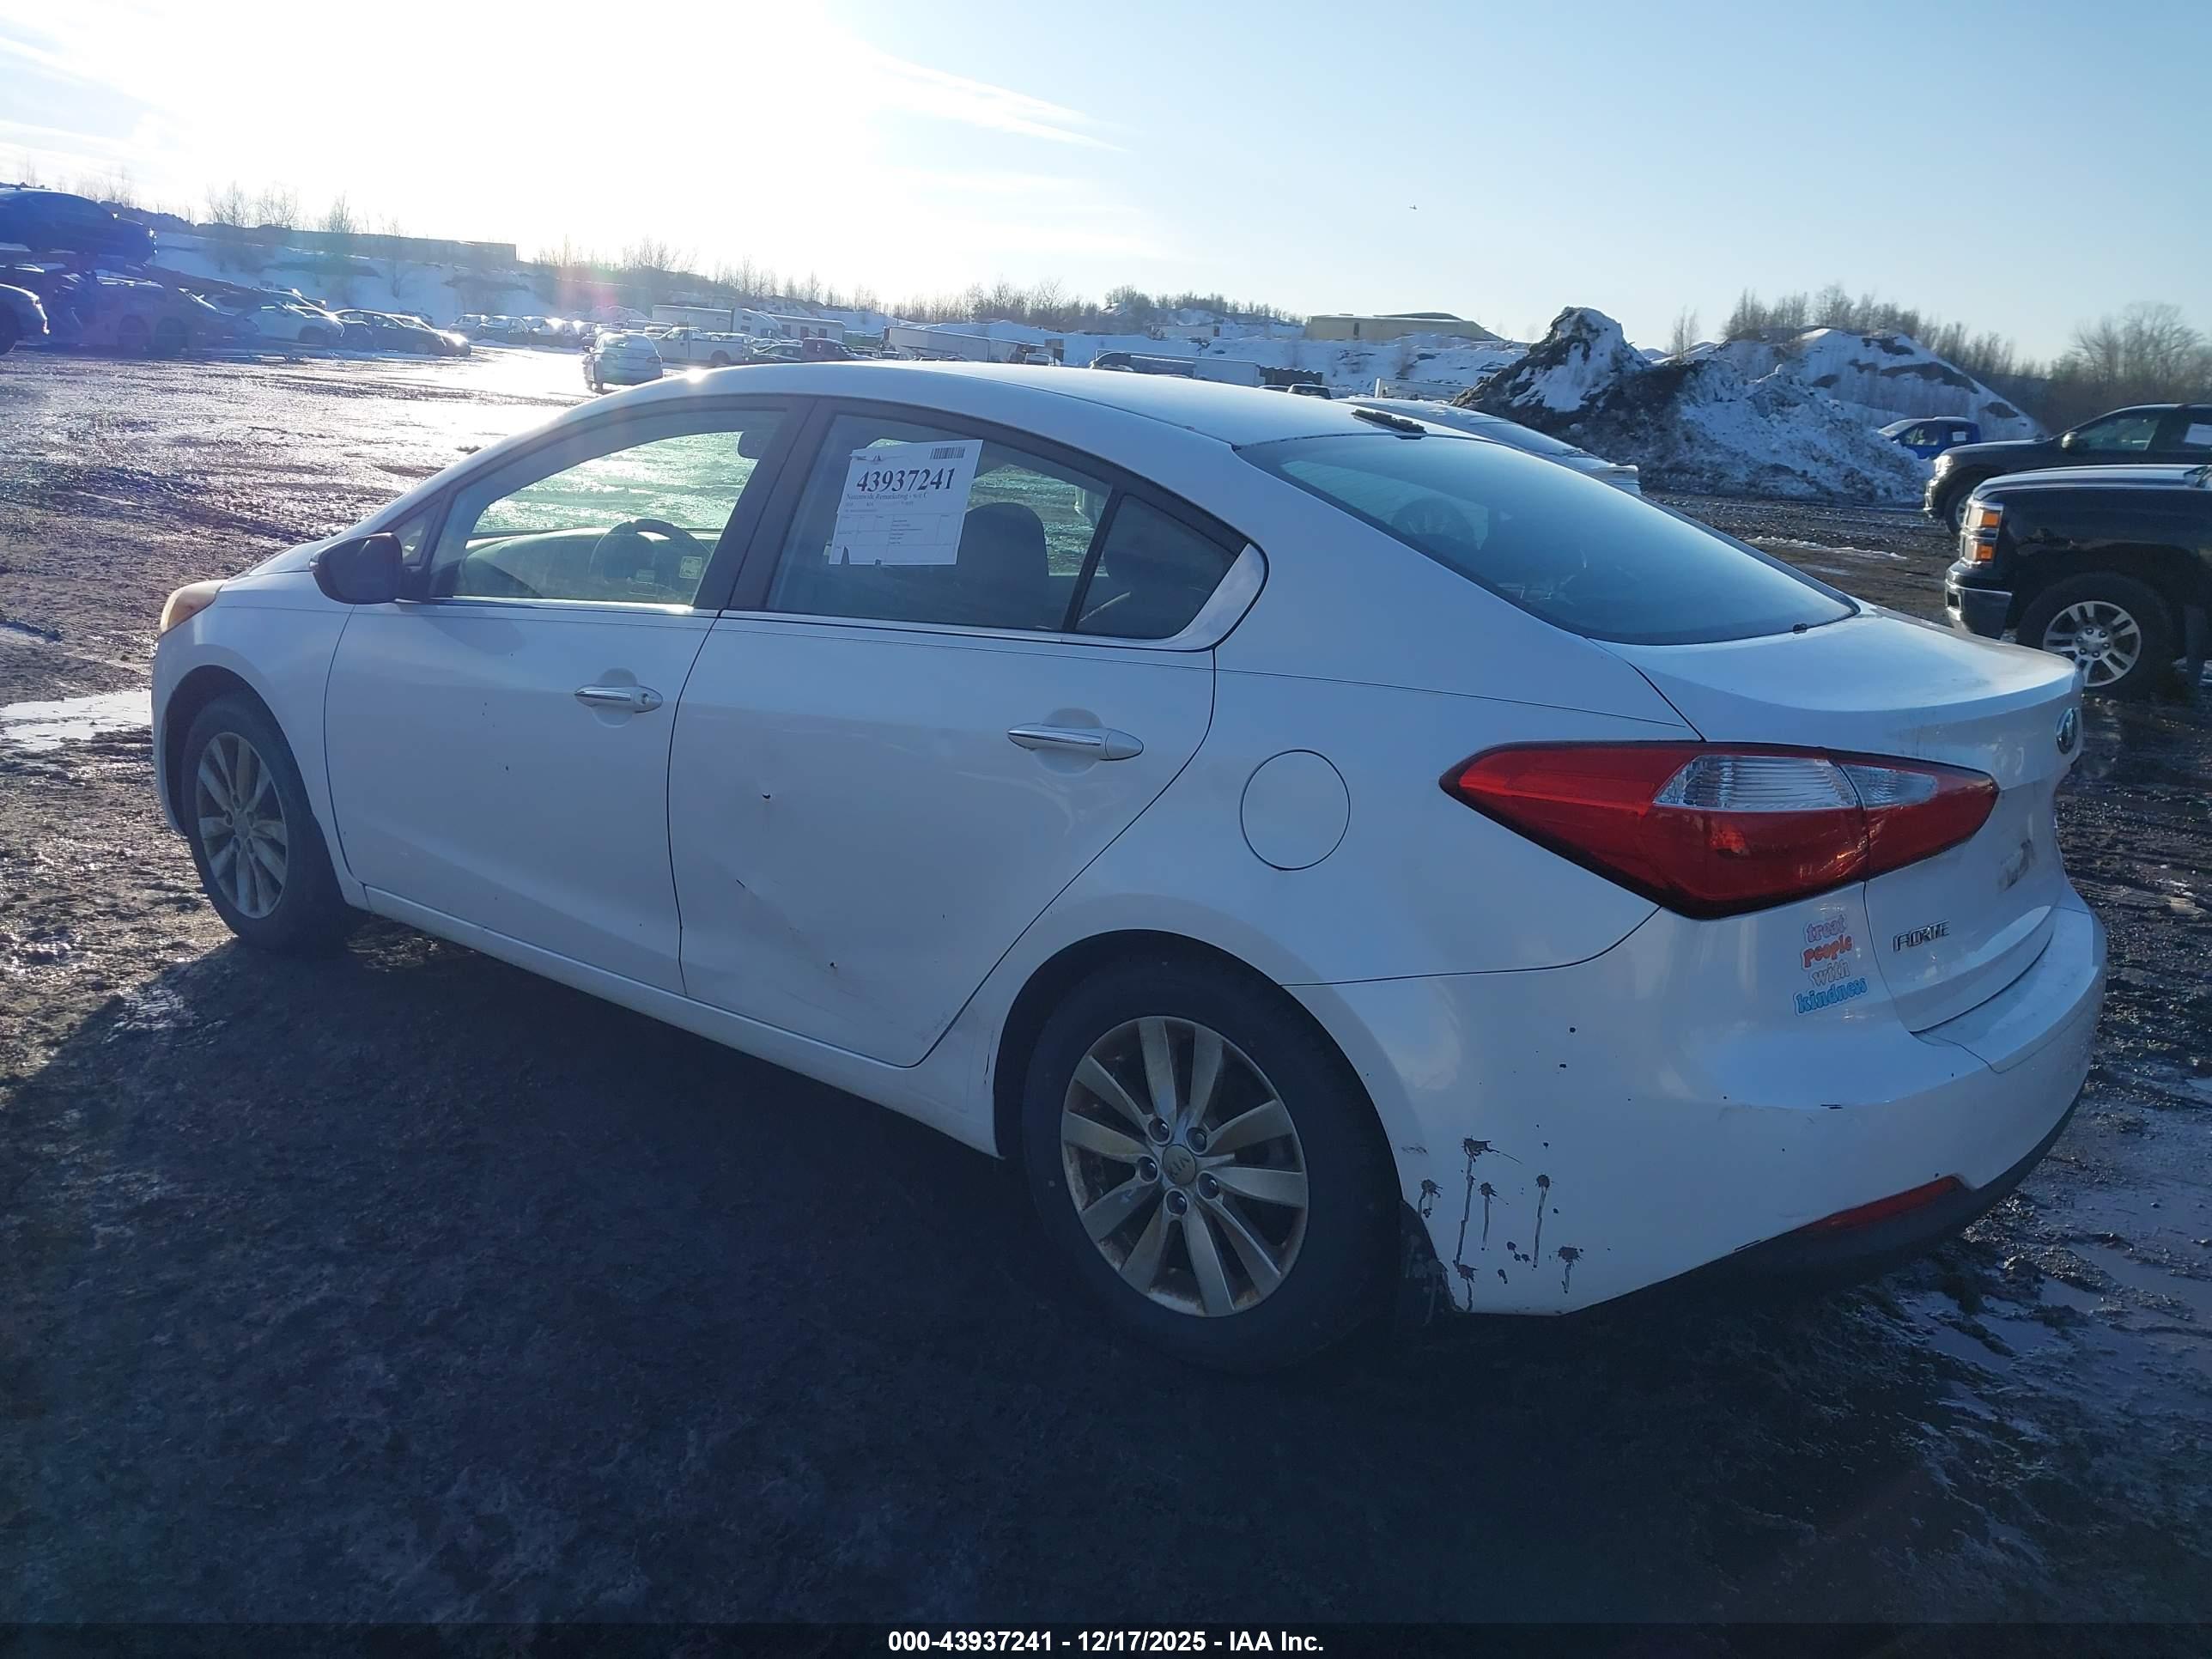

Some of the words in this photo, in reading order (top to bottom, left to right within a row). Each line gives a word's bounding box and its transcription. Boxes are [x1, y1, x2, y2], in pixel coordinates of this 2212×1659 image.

[857, 467, 956, 492] 43937241
[1806, 915, 1847, 943] treat
[1893, 921, 1950, 951] FORTE
[1802, 934, 1853, 968] people
[1812, 960, 1850, 987] with
[1795, 978, 1868, 1014] kindness
